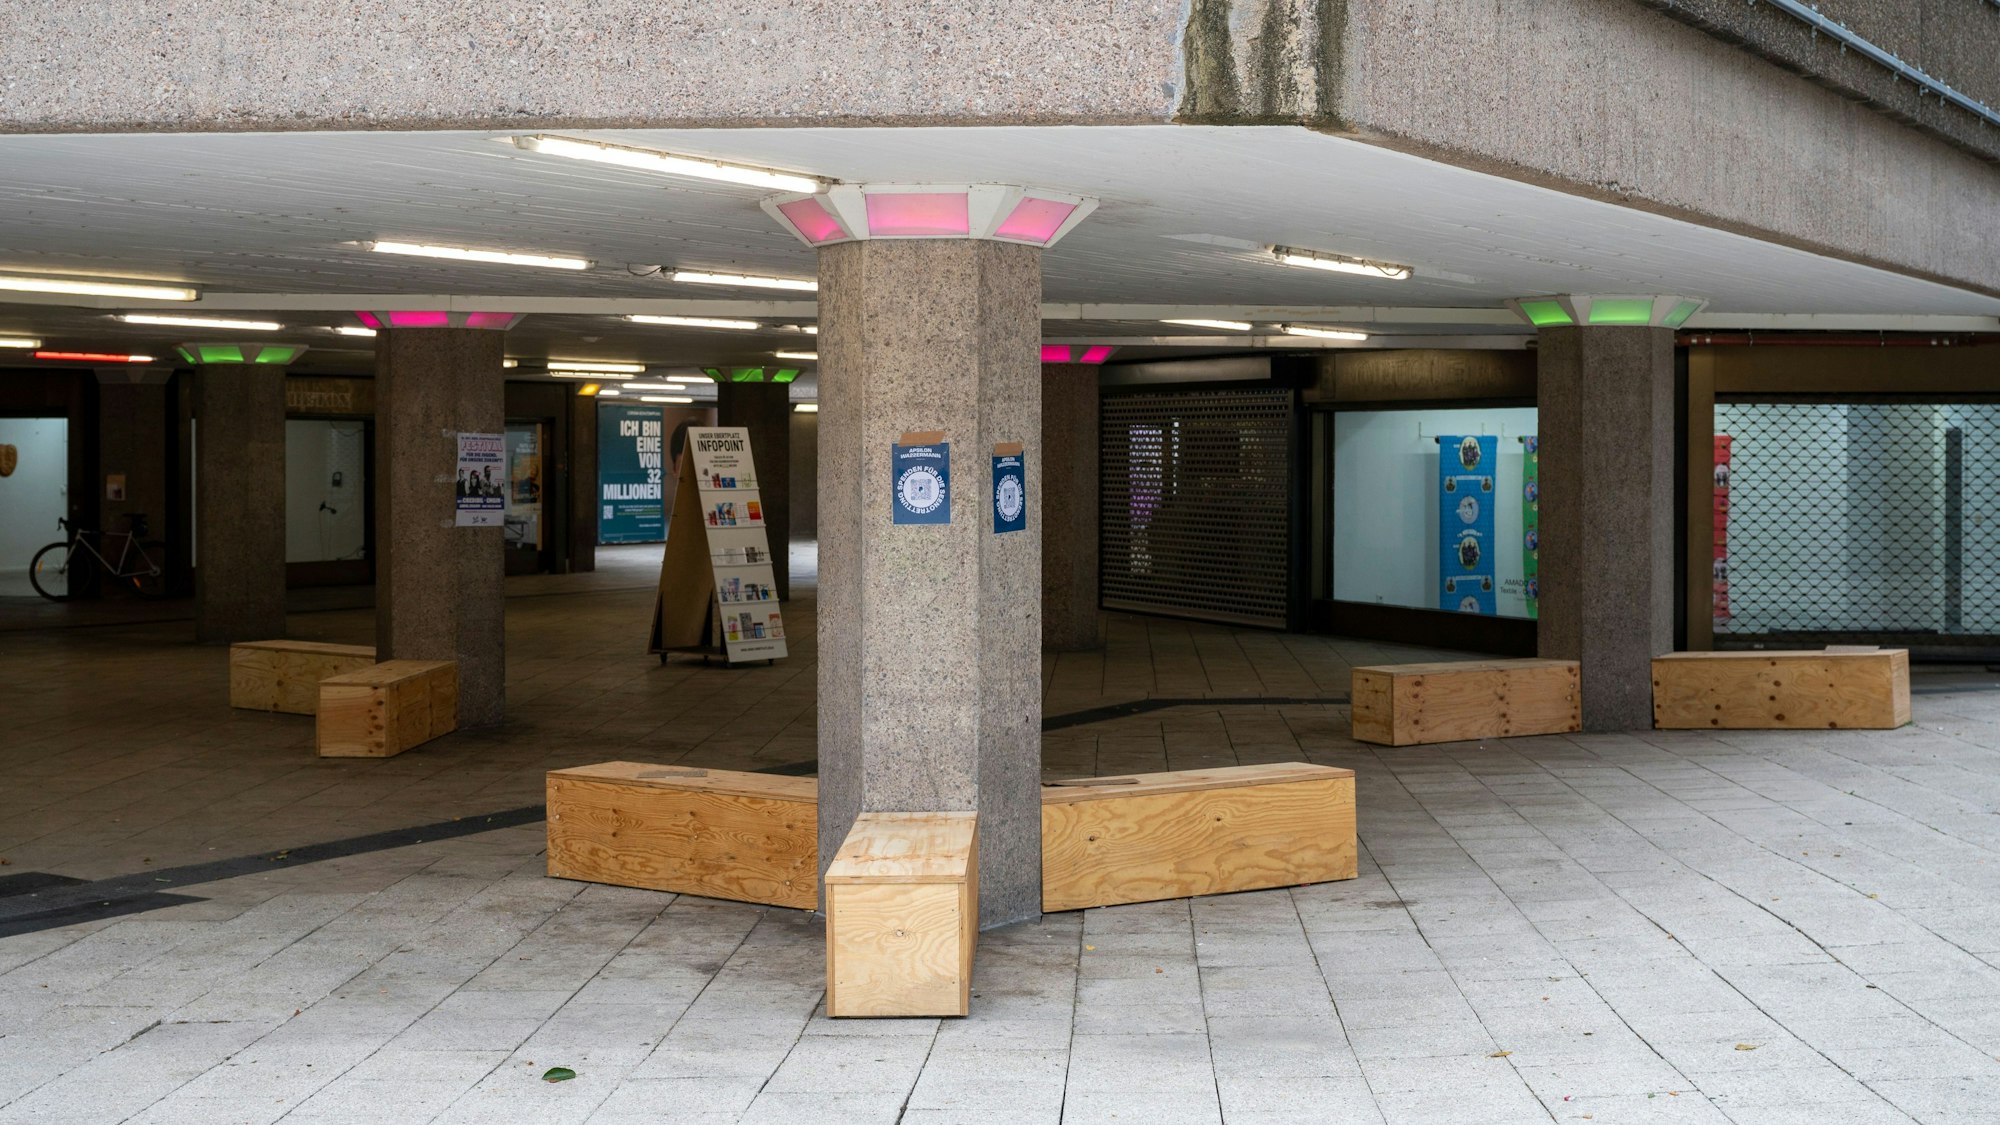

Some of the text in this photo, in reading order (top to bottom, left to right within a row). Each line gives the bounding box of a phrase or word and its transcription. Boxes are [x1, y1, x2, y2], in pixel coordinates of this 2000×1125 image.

[620, 420, 661, 437] ICH BIN
[461, 441, 503, 452] FESTIVAL
[636, 437, 661, 453] EINE
[697, 440, 744, 452] INFOPOINT
[639, 453, 661, 468] VON
[647, 469, 661, 483] 32
[603, 483, 662, 500] MILLIONEN
[897, 465, 946, 514] SPENDEN FÜR DIE SEENOTRETTUNG
